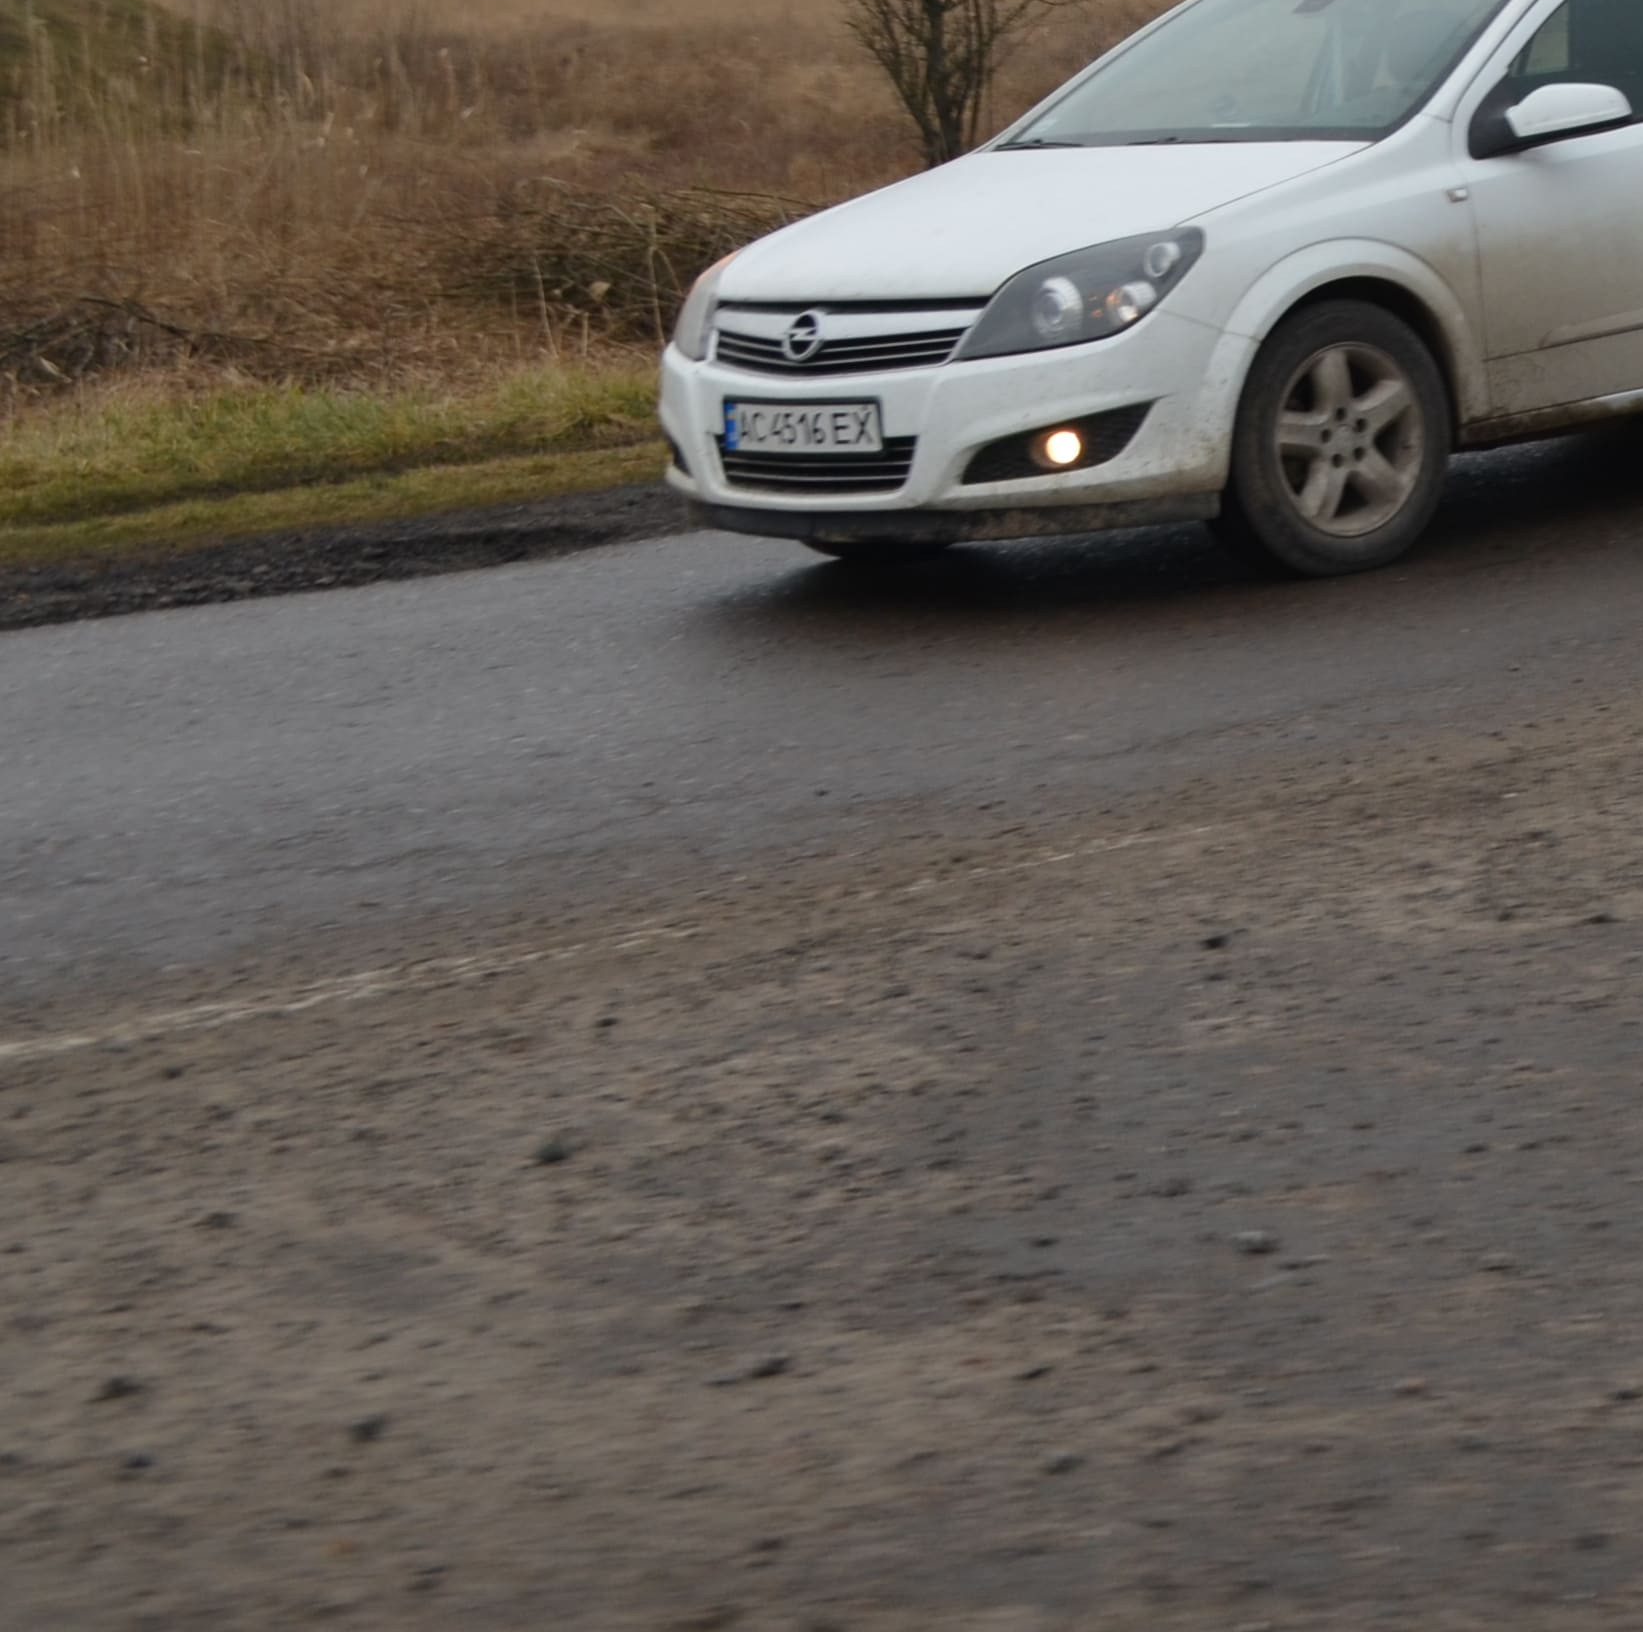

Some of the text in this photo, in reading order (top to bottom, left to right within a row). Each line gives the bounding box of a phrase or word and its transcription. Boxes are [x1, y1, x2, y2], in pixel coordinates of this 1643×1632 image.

[740, 410, 767, 443] AC
[771, 411, 826, 445] 4516
[831, 411, 875, 445] EX
